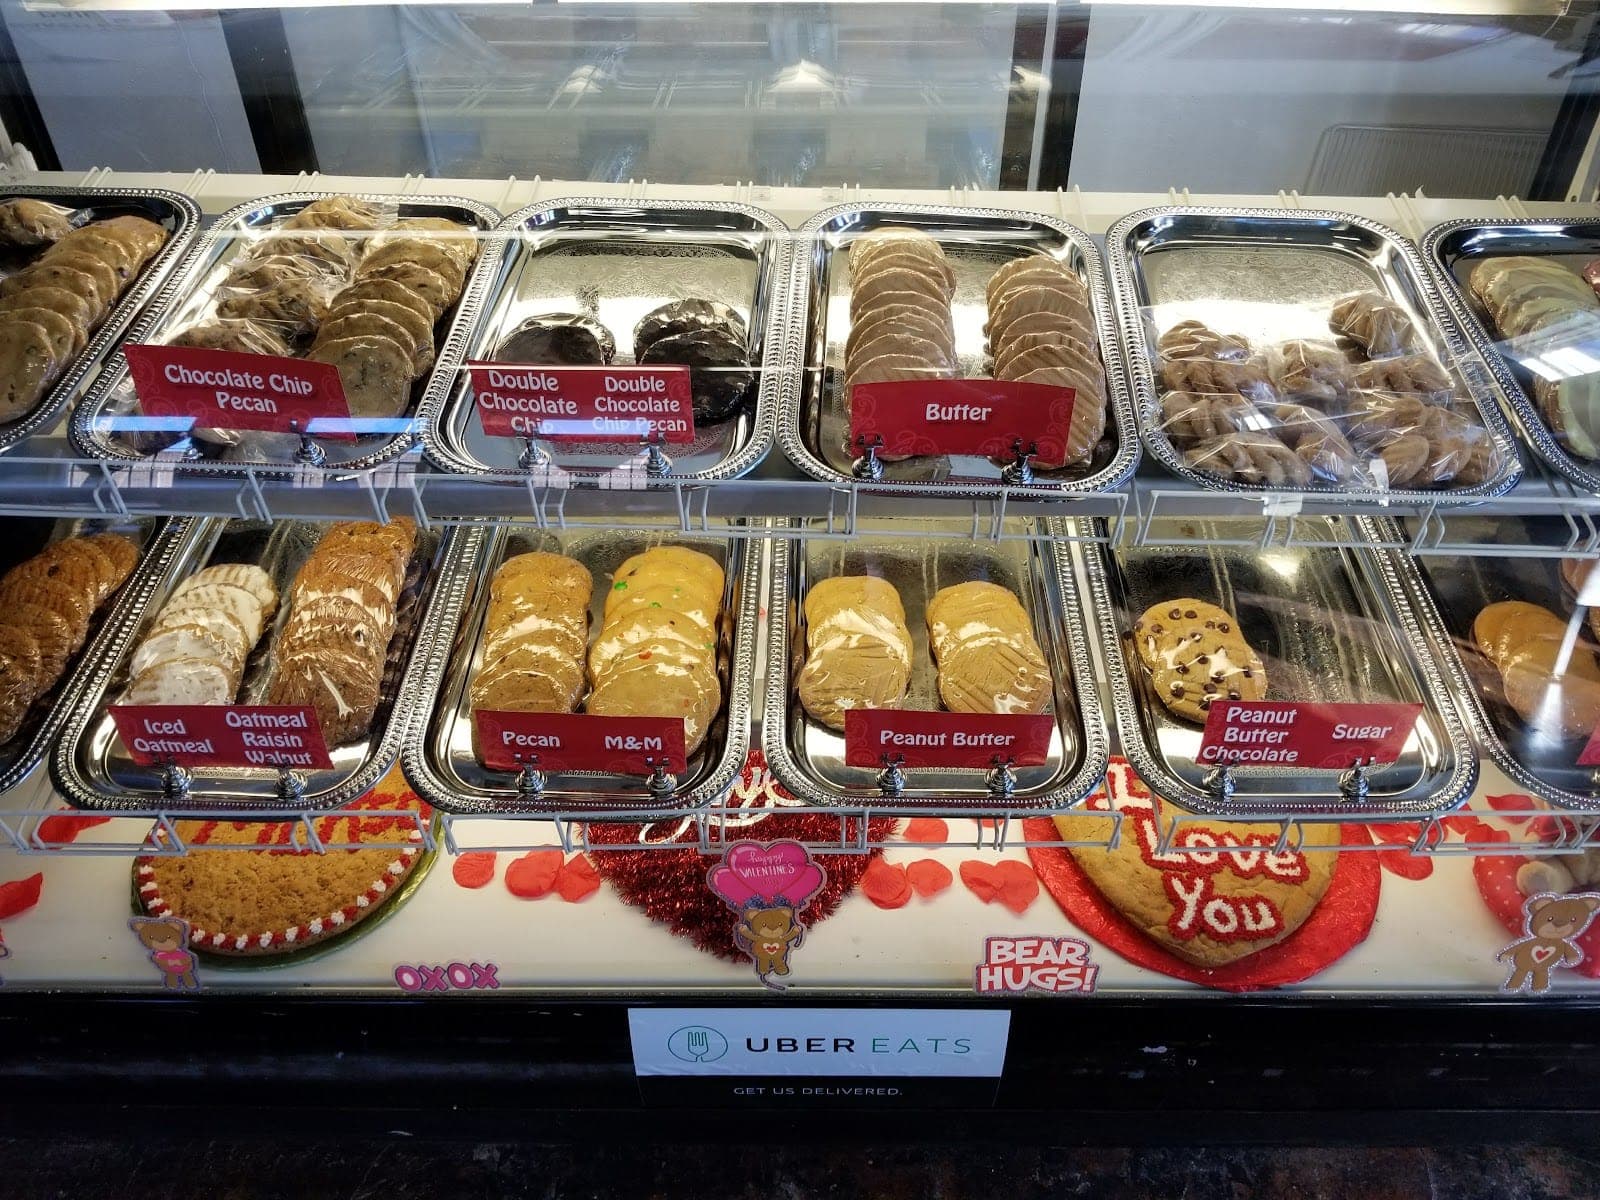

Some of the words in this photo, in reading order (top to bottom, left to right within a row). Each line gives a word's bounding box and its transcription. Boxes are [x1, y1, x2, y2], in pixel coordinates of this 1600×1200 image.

[163, 363, 265, 390] Chocolate
[268, 374, 313, 396] Chip
[488, 369, 560, 392] Double
[604, 376, 666, 393] Double
[215, 391, 278, 414] Pecan
[479, 391, 579, 416] Chocolate
[594, 396, 681, 413] Chocolate
[925, 403, 993, 421] Butter
[510, 416, 554, 434] Chip
[592, 416, 631, 432] Chip
[634, 417, 687, 433] Pecan
[225, 711, 308, 728] Oatmeal
[1226, 706, 1298, 724] Peanut
[143, 719, 187, 735] Iced
[1223, 727, 1289, 744] Butter
[1331, 723, 1393, 740] Sugar
[133, 738, 215, 754] Oatmeal
[242, 732, 303, 748] Raisin
[502, 731, 561, 748] Pecan
[604, 735, 662, 751] M&M
[880, 730, 947, 746] Peanut
[952, 732, 1016, 746] Butter
[245, 750, 313, 765] Walnut
[1202, 745, 1299, 762] Chocolate
[1167, 874, 1277, 933] You
[990, 940, 1086, 966] BEAR
[395, 962, 500, 992] OXOX
[980, 966, 1096, 992] HUGS!
[746, 1037, 856, 1053] UBER
[871, 1038, 972, 1054] EATS
[733, 1087, 766, 1095] GET
[772, 1087, 795, 1095] US
[802, 1087, 903, 1096] DELIVERED.
